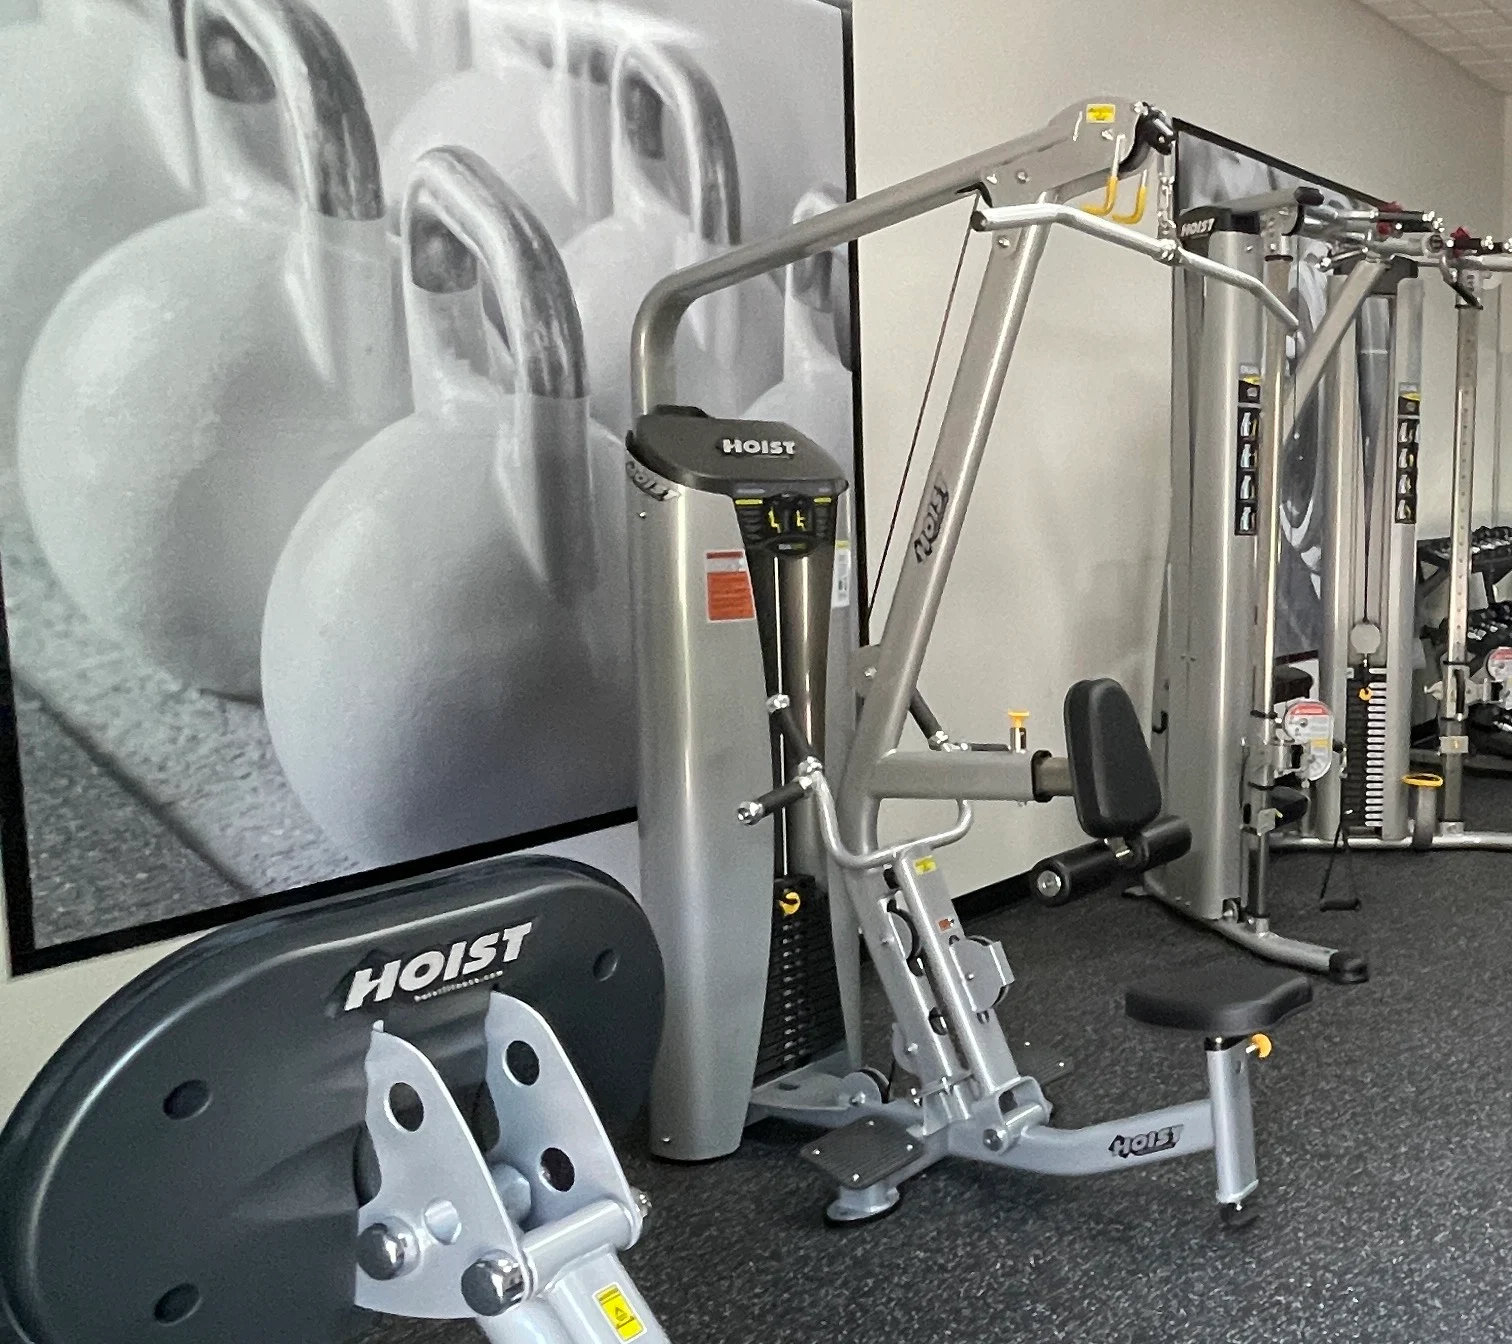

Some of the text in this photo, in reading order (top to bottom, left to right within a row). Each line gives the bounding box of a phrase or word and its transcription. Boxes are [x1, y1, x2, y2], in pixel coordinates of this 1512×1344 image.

[1181, 218, 1215, 237] HOIST
[722, 438, 796, 455] HOIST
[914, 474, 949, 563] HOIST
[343, 922, 533, 1012] HOIST
[1110, 1123, 1184, 1159] HOIST
